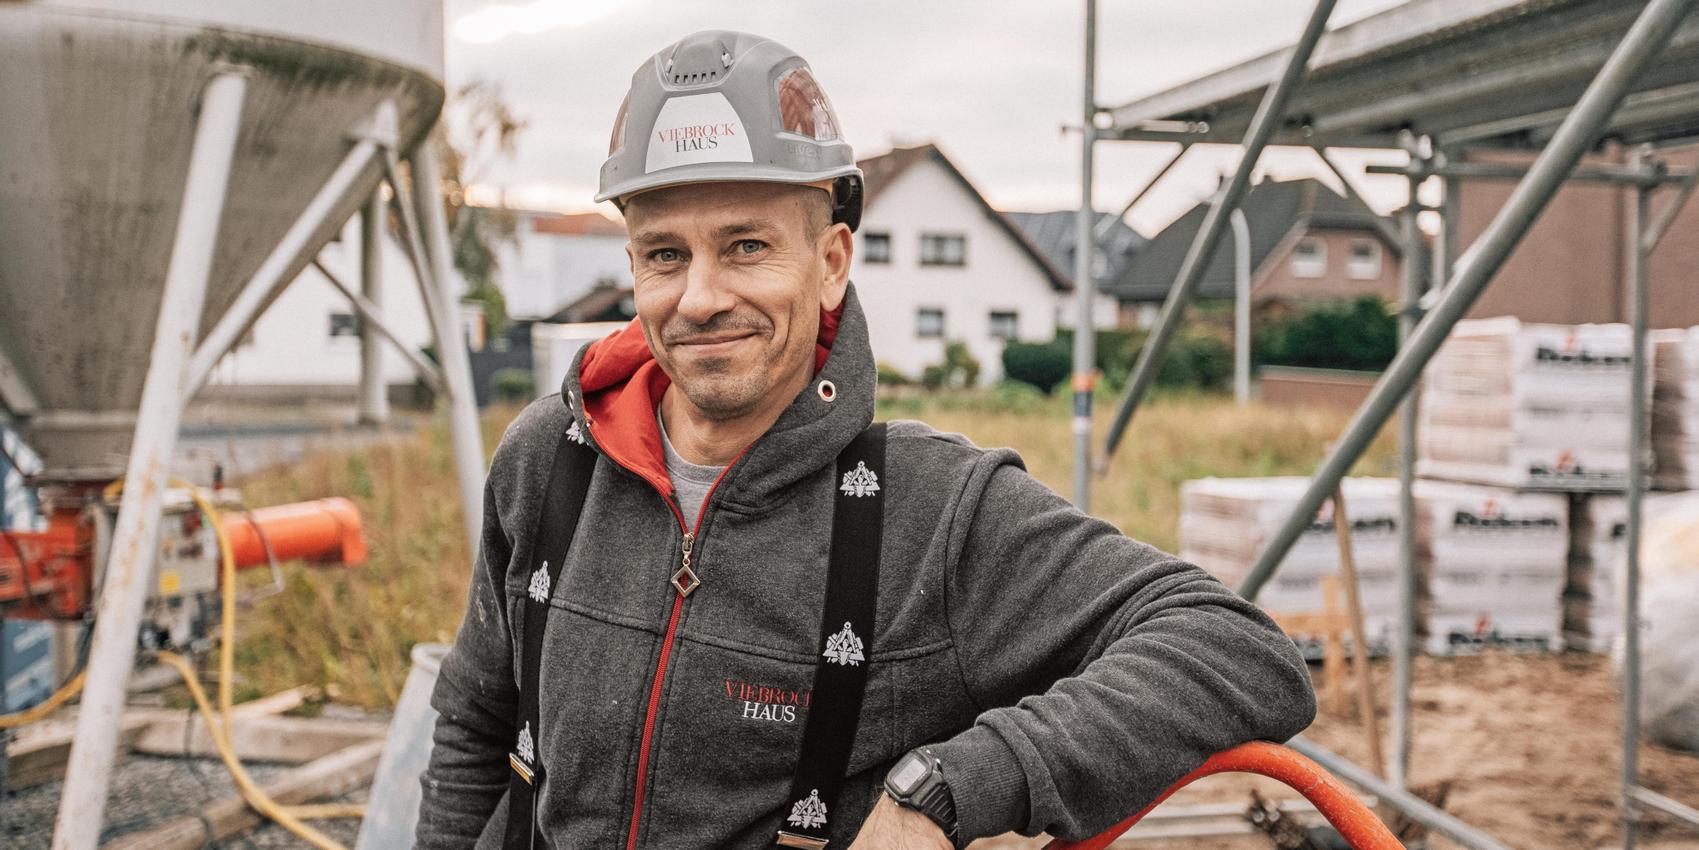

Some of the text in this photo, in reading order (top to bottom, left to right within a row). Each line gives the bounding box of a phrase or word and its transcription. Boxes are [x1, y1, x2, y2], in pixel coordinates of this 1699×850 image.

[658, 123, 735, 143] VIEBROCK
[675, 136, 718, 152] HAUS
[742, 700, 796, 722] HAUS
